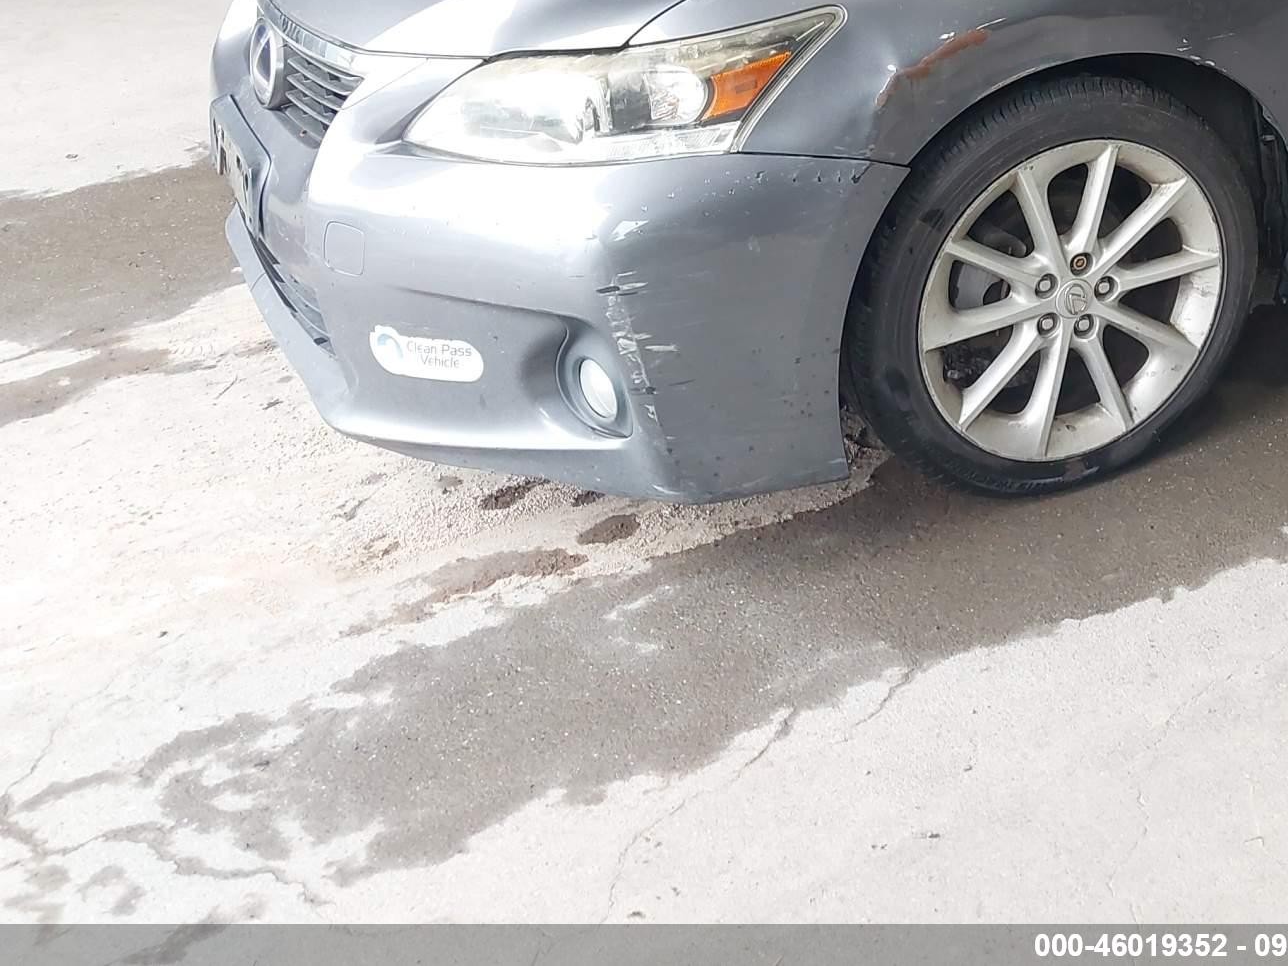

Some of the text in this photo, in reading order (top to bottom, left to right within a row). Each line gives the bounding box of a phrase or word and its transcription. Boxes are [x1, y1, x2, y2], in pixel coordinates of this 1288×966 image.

[406, 340, 472, 357] Clean Pass
[420, 354, 460, 369] Vehicle
